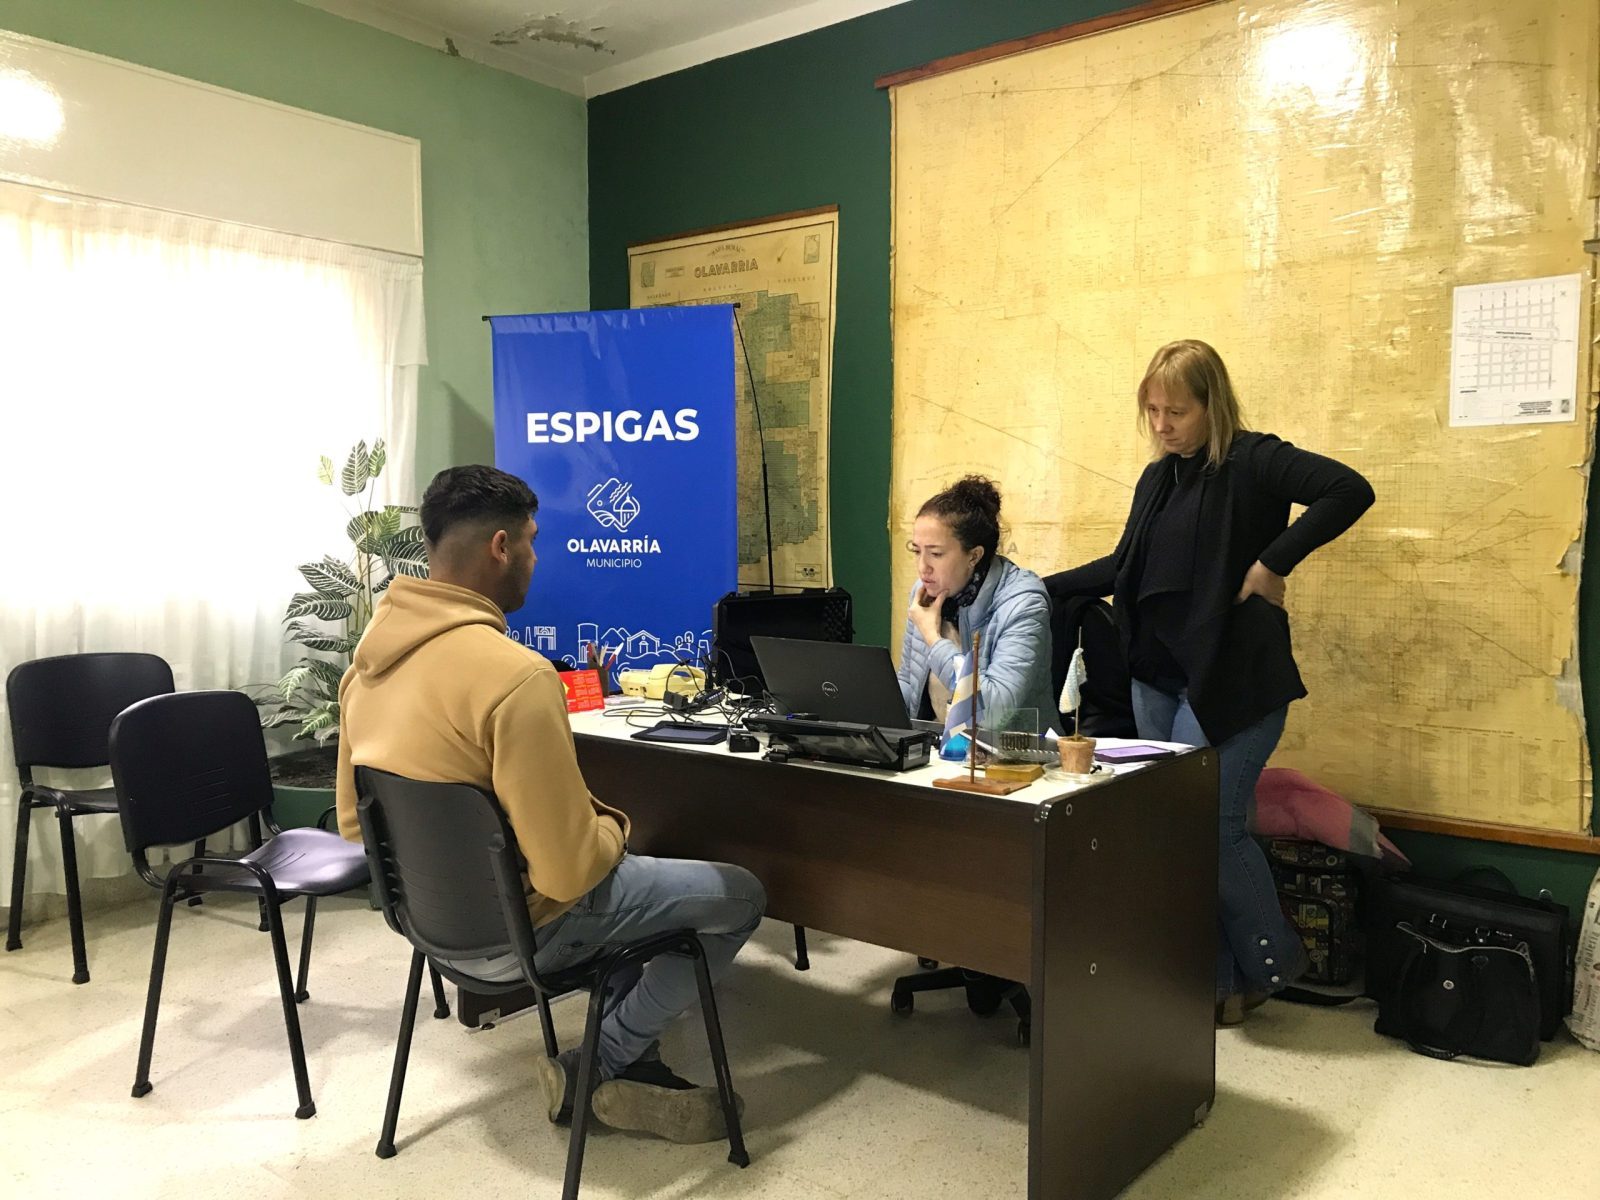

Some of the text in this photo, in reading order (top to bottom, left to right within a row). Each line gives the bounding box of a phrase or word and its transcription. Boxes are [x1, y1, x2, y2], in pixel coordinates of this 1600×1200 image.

[694, 259, 759, 278] OLAVARRIA
[526, 408, 700, 444] ESPIGAS
[567, 535, 661, 554] OLAVARRÍA
[586, 558, 642, 568] MUNICIPIO
